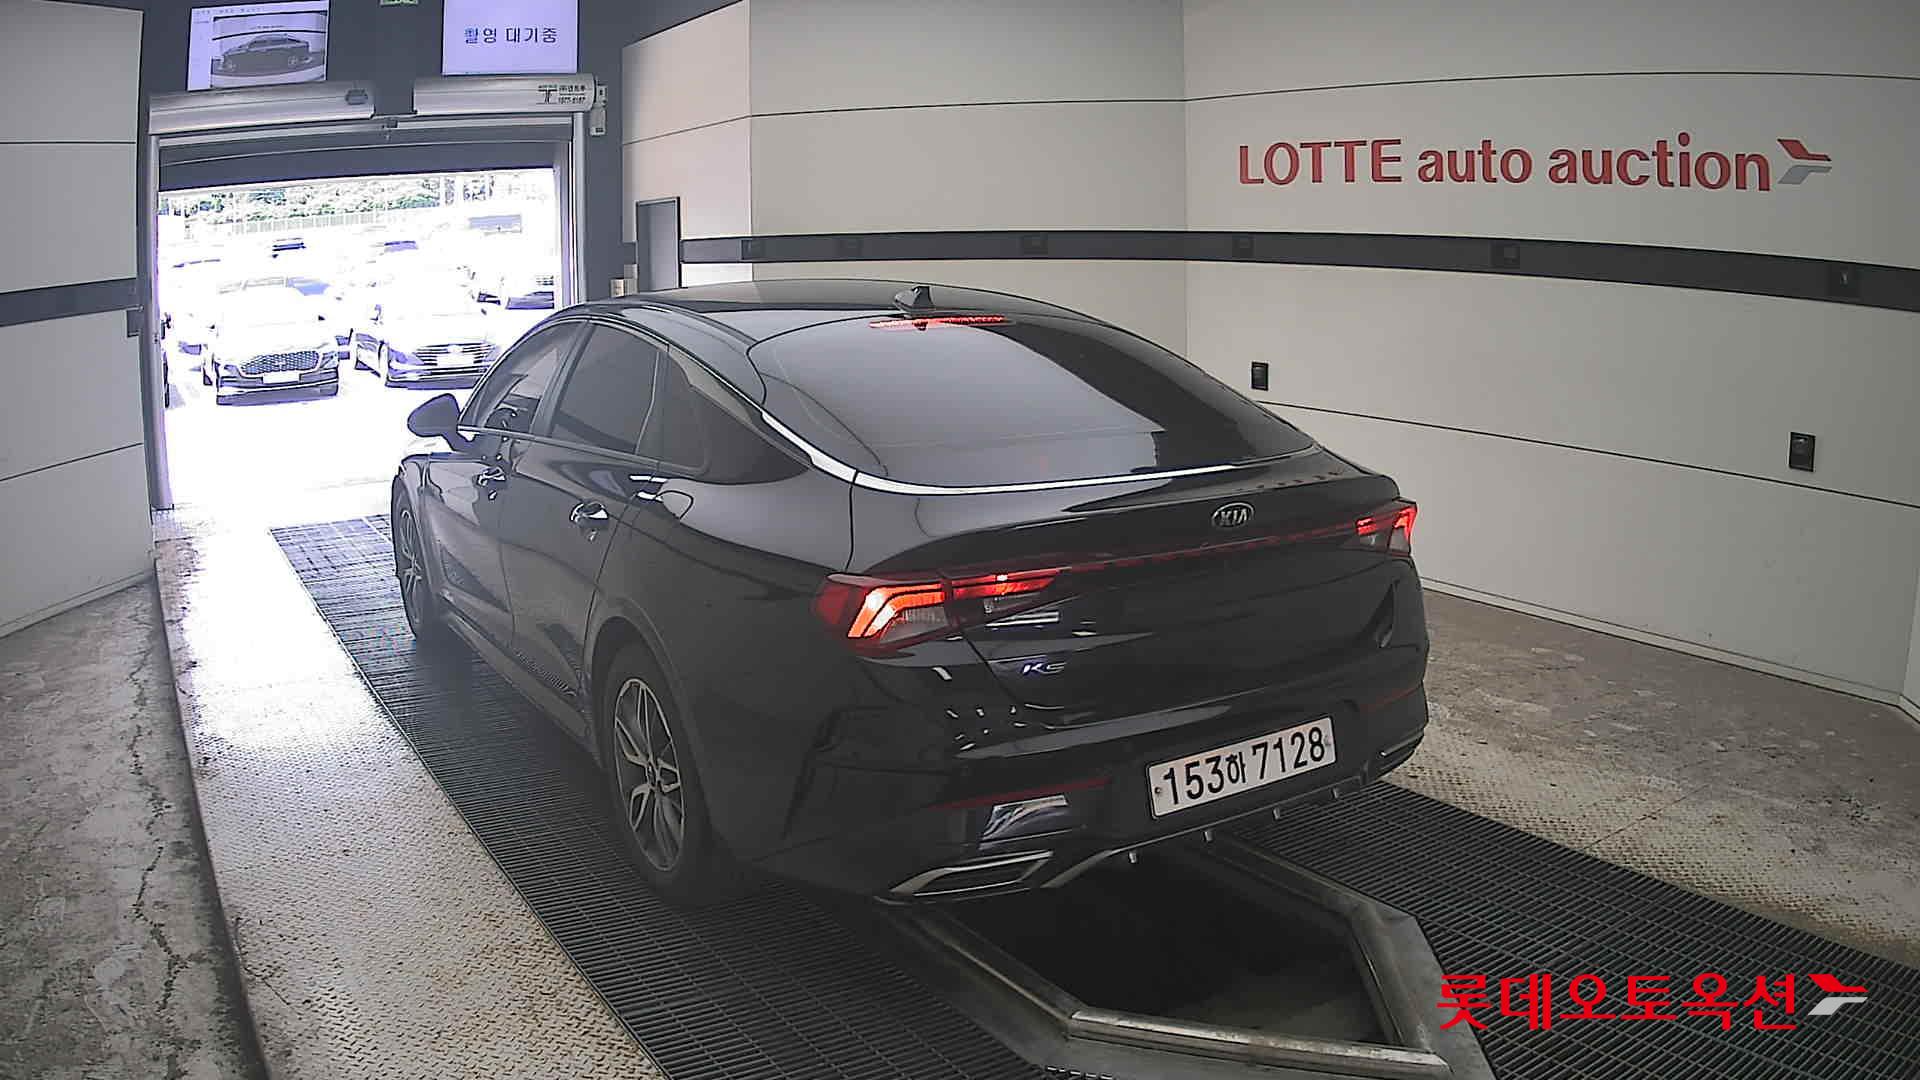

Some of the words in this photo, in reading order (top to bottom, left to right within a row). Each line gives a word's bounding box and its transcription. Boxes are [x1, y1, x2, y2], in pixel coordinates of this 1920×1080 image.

[505, 27, 558, 43] 대기중
[1239, 139, 1402, 185] LOTTE
[1417, 140, 1533, 184] auto
[1548, 132, 1772, 192] auction
[1218, 507, 1250, 526] KIA
[1163, 751, 1247, 805] 153하
[1252, 727, 1326, 780] 7128
